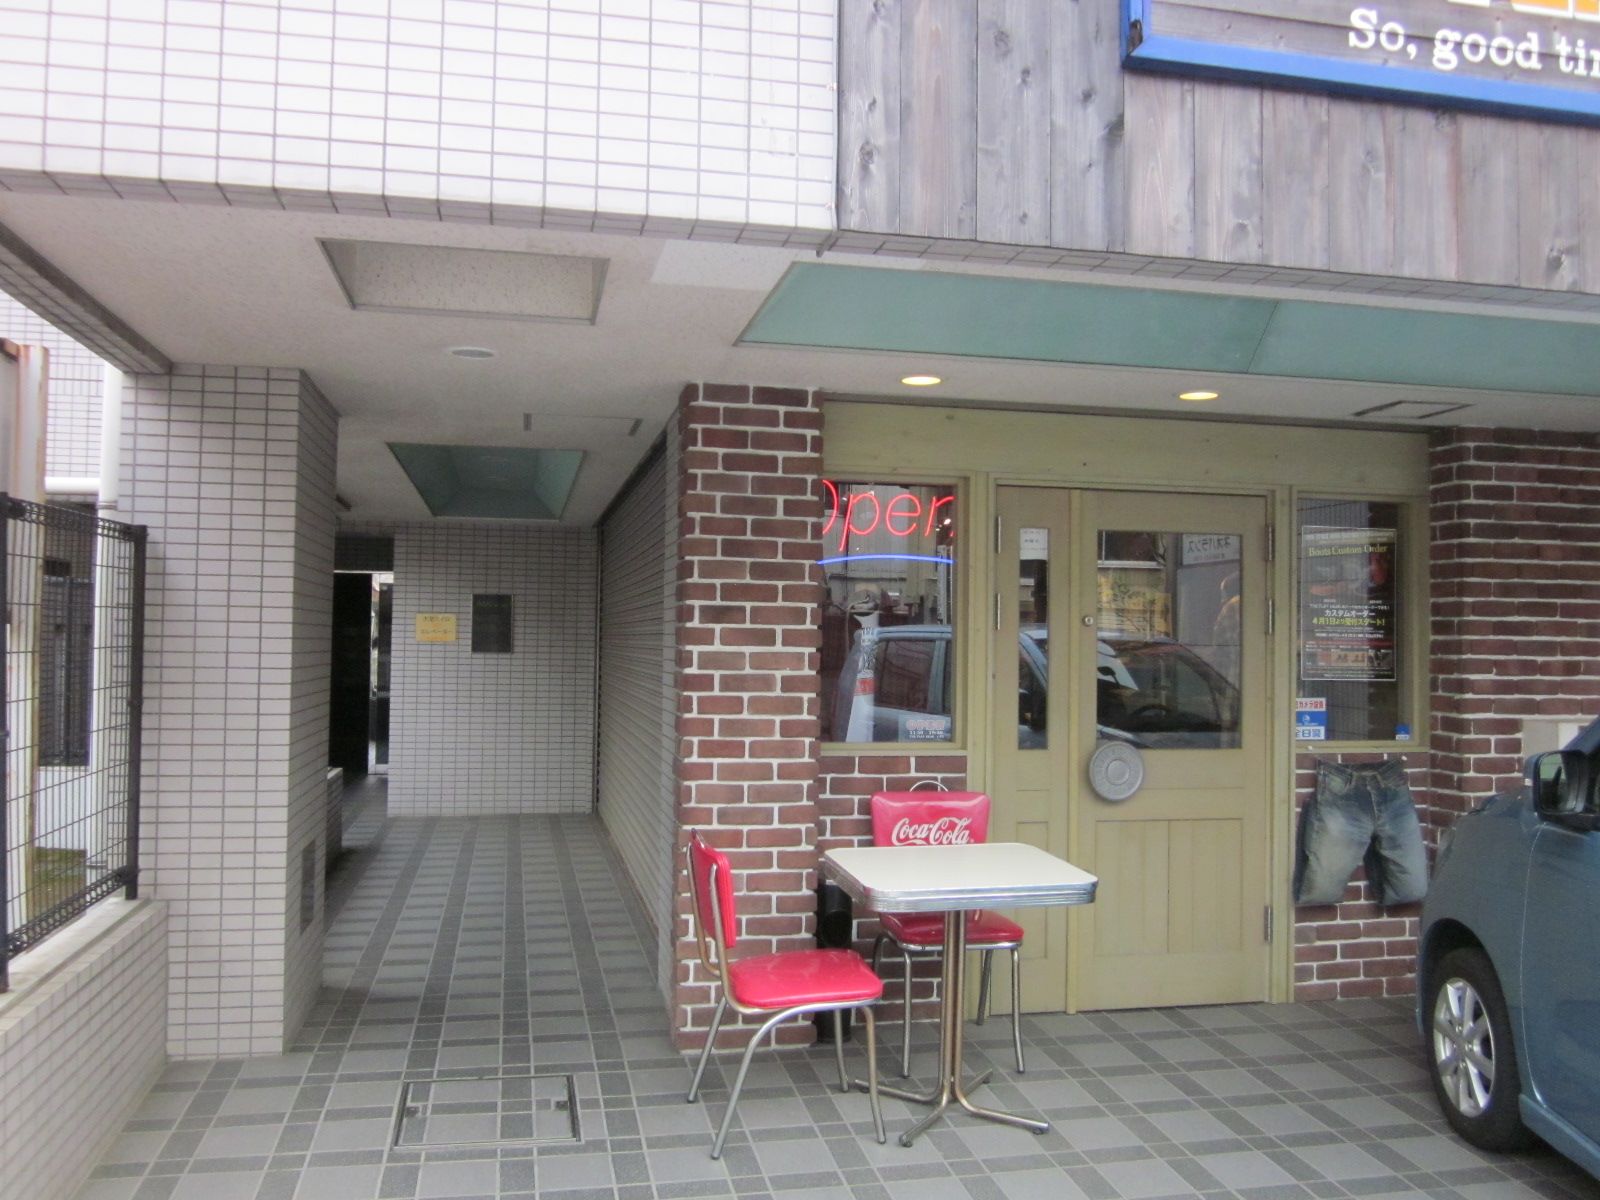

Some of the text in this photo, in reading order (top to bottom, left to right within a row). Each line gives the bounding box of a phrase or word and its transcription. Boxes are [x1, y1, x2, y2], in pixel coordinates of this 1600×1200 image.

[1348, 8, 1600, 78] So, good ti
[1332, 545, 1363, 555] Custom
[1364, 544, 1388, 553] Order
[1324, 609, 1376, 617] カスタムオーダー
[891, 817, 972, 846] Coca-Cola
